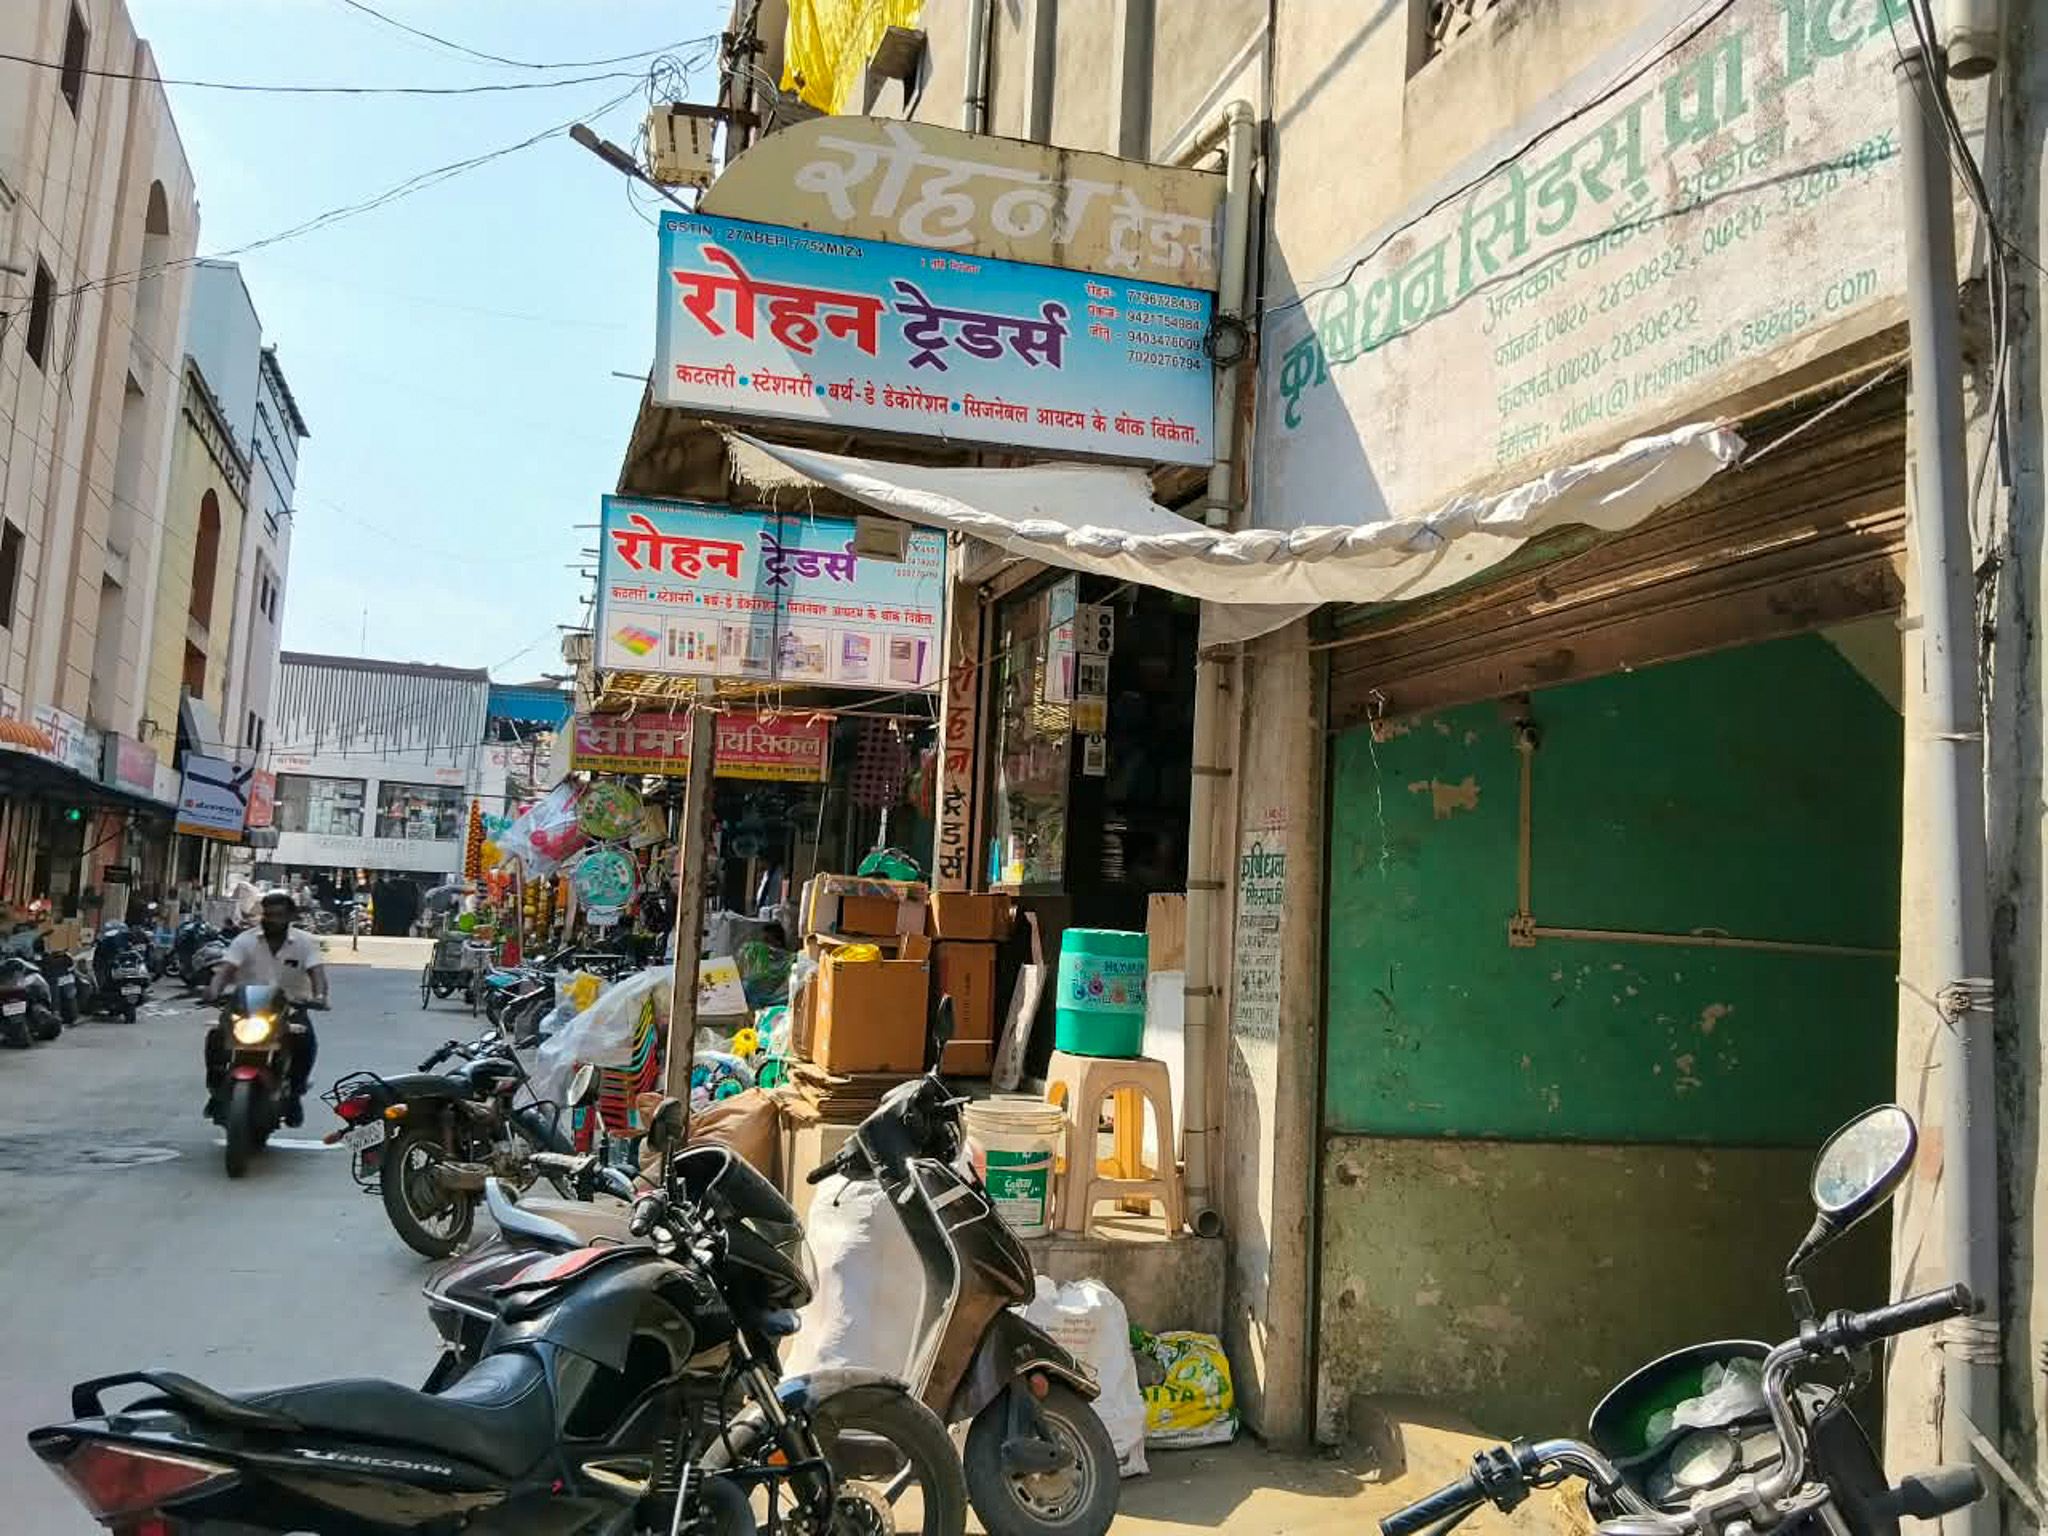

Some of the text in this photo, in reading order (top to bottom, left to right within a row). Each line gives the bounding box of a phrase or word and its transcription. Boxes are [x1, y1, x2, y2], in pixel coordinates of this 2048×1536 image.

[794, 122, 1127, 248] रोहन
[666, 220, 713, 236] GSTIN
[674, 246, 1068, 372] रोहन ट्रेडर्स
[676, 364, 736, 388] कटलरी
[752, 367, 813, 398] स्टेशनरी
[829, 378, 875, 407] बर्थ-डे
[883, 384, 949, 414] डेकोरेशन
[963, 393, 1028, 423] सिजनेबल
[1036, 408, 1085, 430] आयटम
[1091, 409, 1106, 433] के
[1114, 412, 1145, 437] थोक
[612, 514, 744, 579] रोहन
[758, 531, 858, 588] ट्रेडर्स
